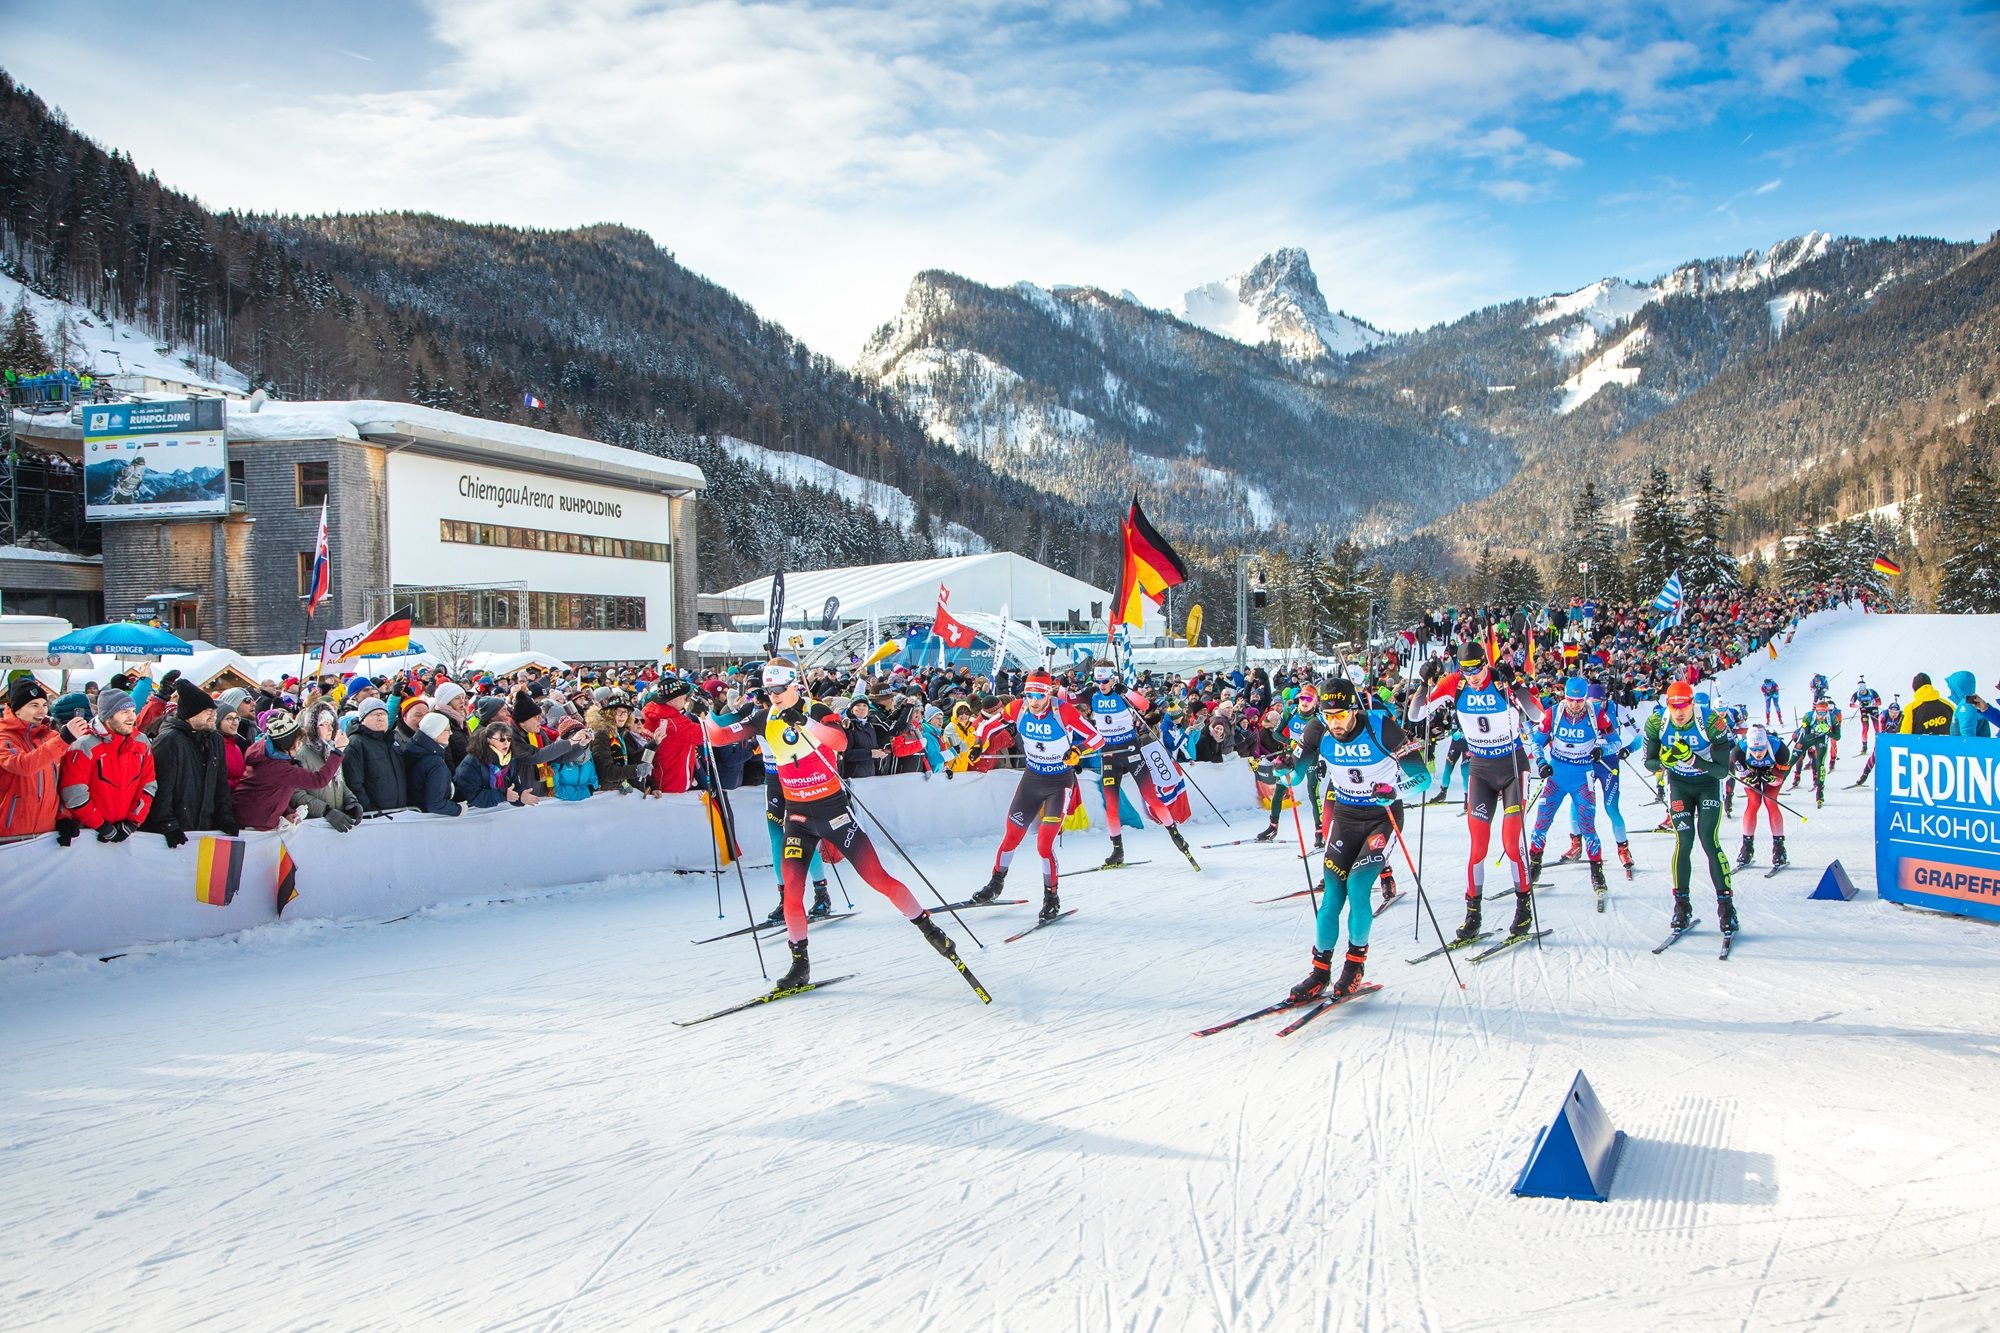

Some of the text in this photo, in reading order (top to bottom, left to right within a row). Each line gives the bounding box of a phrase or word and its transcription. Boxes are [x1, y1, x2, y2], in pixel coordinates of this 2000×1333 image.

[130, 413, 191, 424] RUHPOLDING
[458, 475, 622, 518] ChiemgauArena RUHPOLDING
[825, 599, 836, 619] JOKA
[105, 644, 144, 654] ERDINGER
[1098, 699, 1117, 708] DKB
[1467, 694, 1497, 706] DKB
[1026, 721, 1052, 735] DKB
[1478, 716, 1490, 733] 9
[1923, 715, 1947, 729] TOKO
[1559, 727, 1585, 738] DKB
[1334, 743, 1371, 757] DKB
[1348, 768, 1365, 784] 3
[1398, 773, 1427, 792] FRANCE
[1890, 746, 2000, 806] ERDIN
[1351, 855, 1384, 870] odlo
